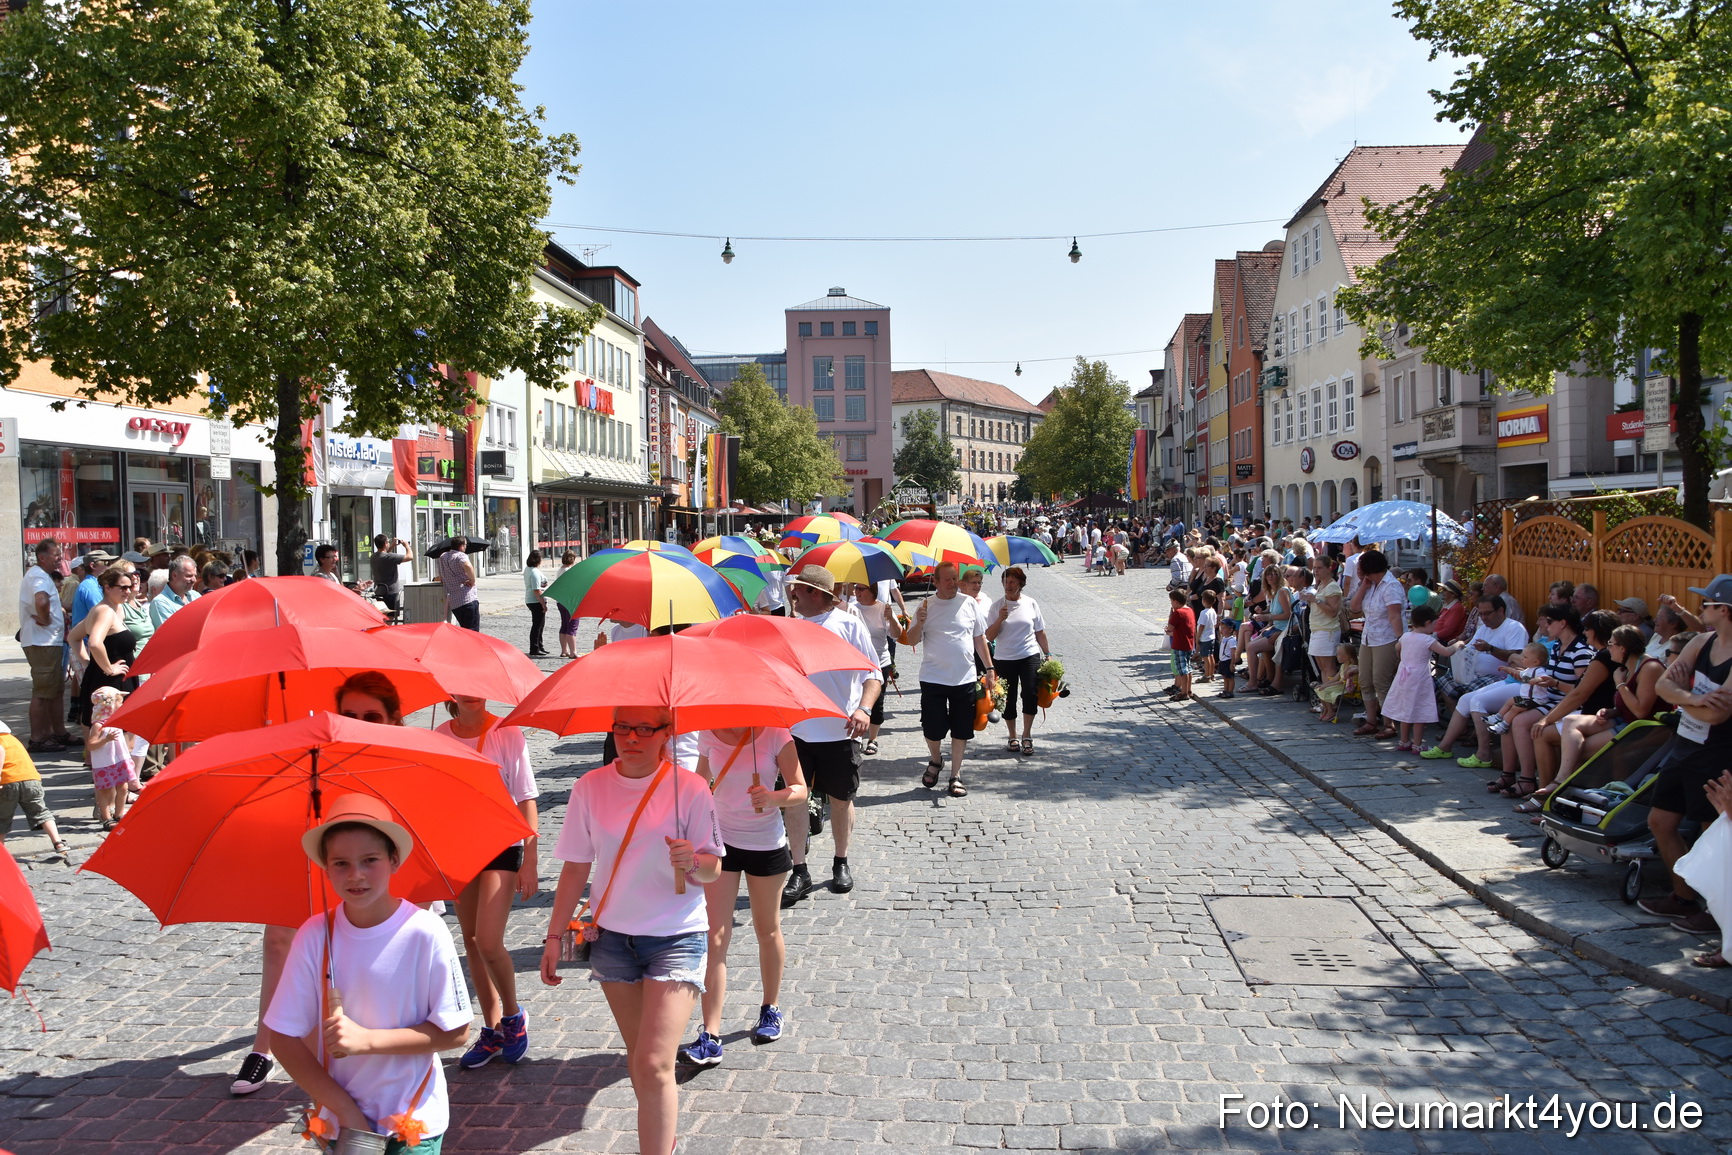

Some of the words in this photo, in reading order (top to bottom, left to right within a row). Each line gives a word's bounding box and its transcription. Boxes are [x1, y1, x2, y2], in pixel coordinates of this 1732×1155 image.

[128, 416, 191, 447] orsay
[1498, 416, 1540, 437] NORMA
[1338, 445, 1354, 455] C&A
[483, 462, 503, 470] BONITA
[27, 532, 40, 540] FINAL
[76, 531, 88, 540] FINAL
[89, 531, 99, 540] SALE
[305, 547, 312, 558] P
